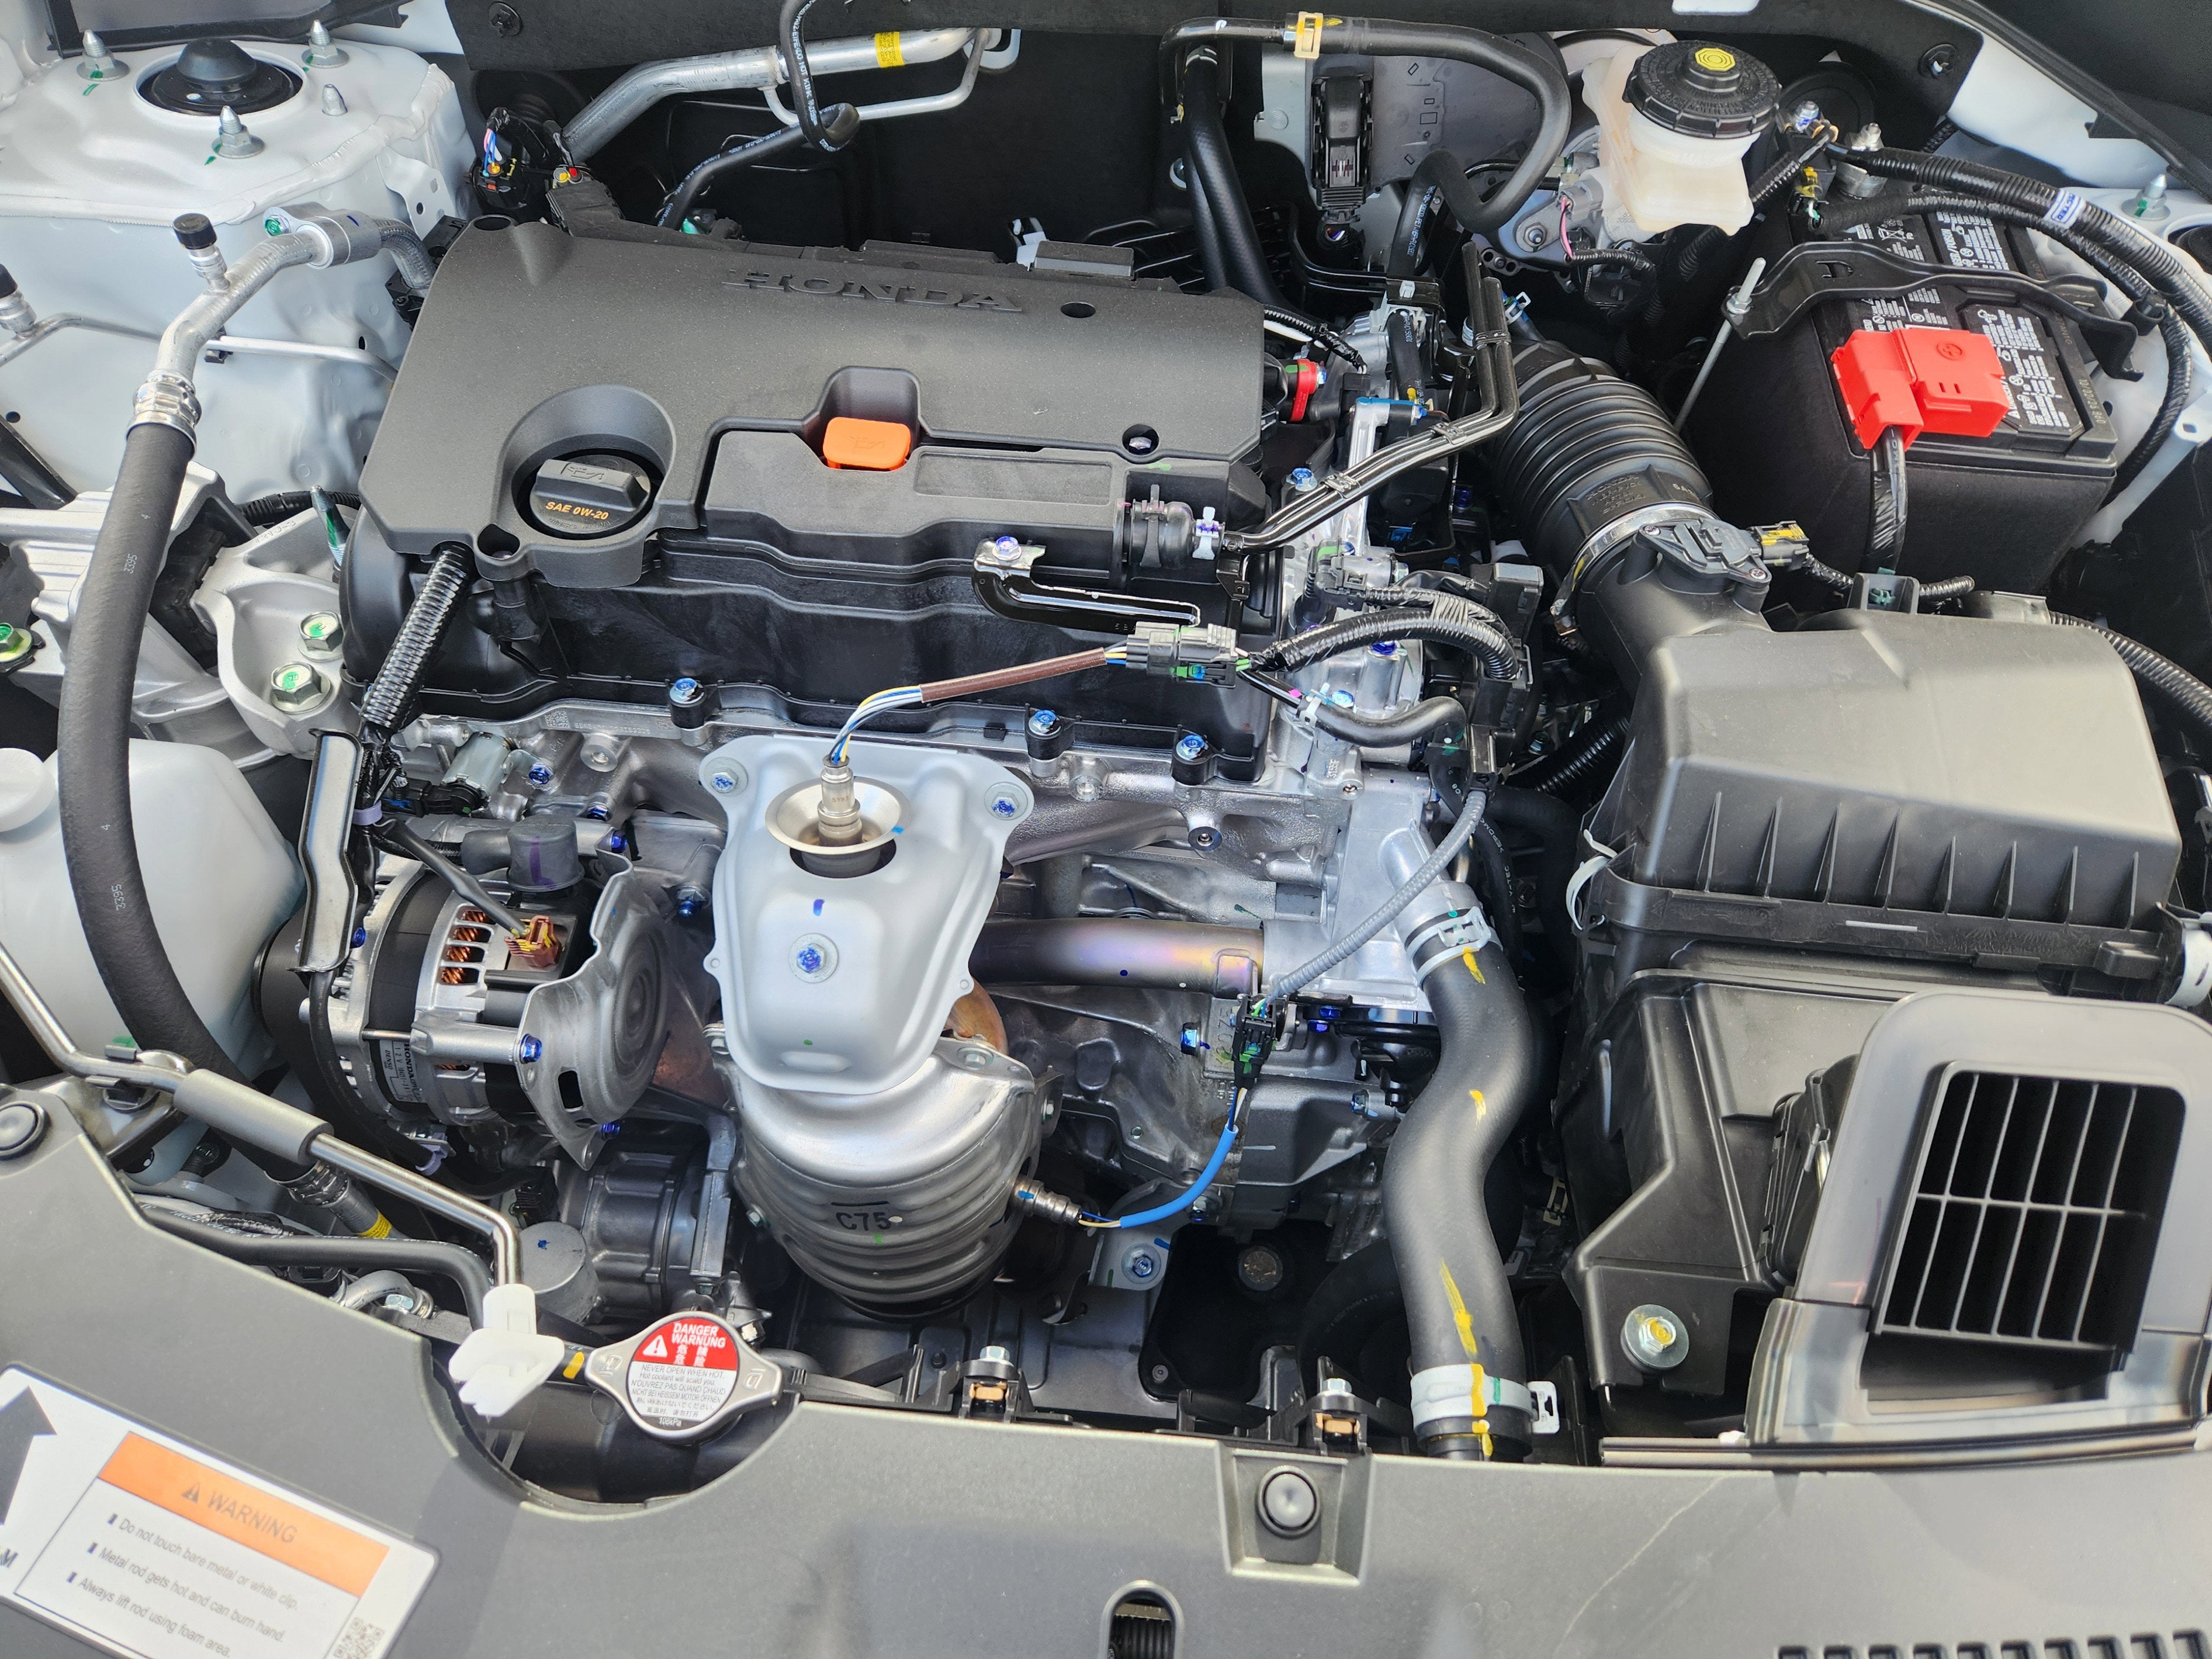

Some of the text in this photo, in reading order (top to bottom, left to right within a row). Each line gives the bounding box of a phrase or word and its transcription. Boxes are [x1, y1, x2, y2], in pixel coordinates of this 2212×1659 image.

[803, 78, 813, 98] KINK
[722, 269, 1022, 312] HONDA
[546, 502, 609, 520] SAE 0W-20
[123, 553, 138, 574] 3395
[385, 1049, 393, 1071] DENSO
[404, 1043, 415, 1079] HONDA
[836, 1211, 892, 1231] C75
[672, 1322, 719, 1337] DANGER
[671, 1332, 727, 1349] WARNUNG
[641, 1364, 725, 1379] NEVER OPEN WHEN HOT.
[631, 1380, 664, 1389] N'OUVREZ
[679, 1384, 702, 1392] QUAND
[703, 1386, 726, 1395] CHAUD
[207, 1491, 298, 1544] WARNING
[119, 1519, 298, 1611] Do not touch bare metal or white clip.
[98, 1546, 286, 1643] Metal rod gets hot and can burn hand.
[78, 1578, 232, 1658] Always lift rod using foam area.
